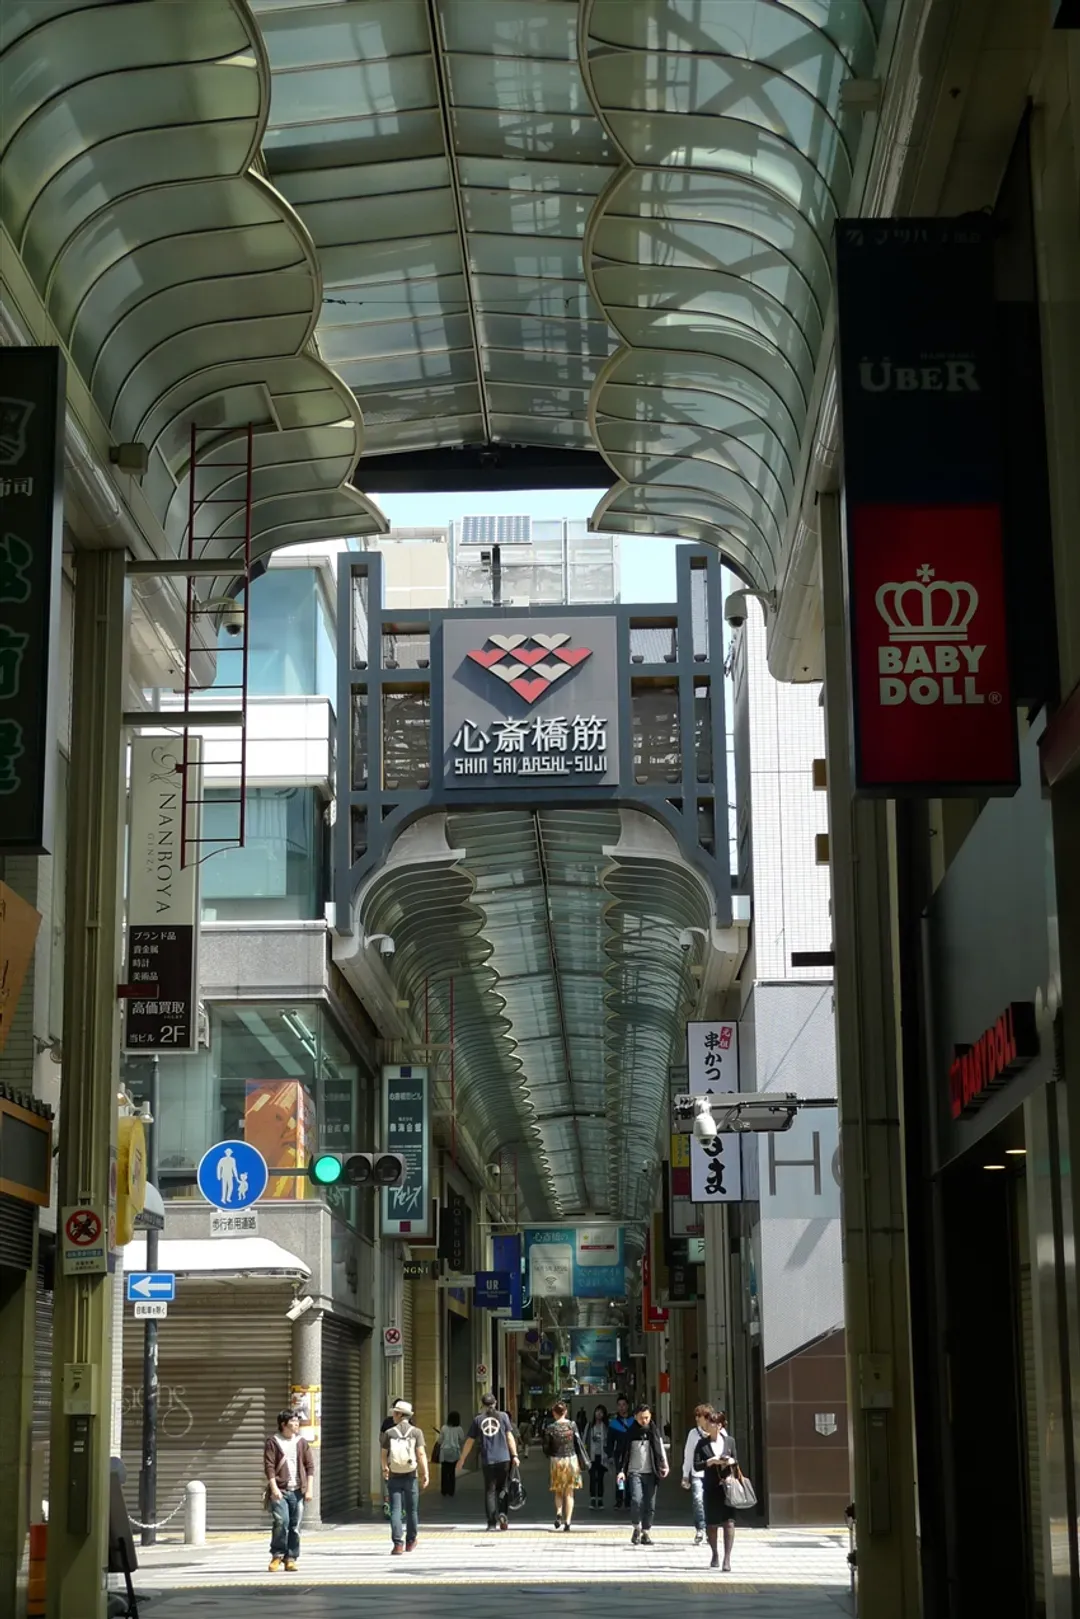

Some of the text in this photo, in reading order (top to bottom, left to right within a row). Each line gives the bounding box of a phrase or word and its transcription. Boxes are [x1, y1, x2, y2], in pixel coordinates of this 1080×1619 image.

[877, 645, 987, 674] BABY
[879, 676, 985, 707] DOLL
[453, 715, 608, 753] 心斎橋筋
[454, 758, 488, 775] SHIN
[156, 793, 177, 913] NANBOYA
[134, 931, 177, 940] ブランド品
[132, 958, 150, 968] 時計
[133, 971, 159, 981] 美術品
[132, 1001, 185, 1015] 高価買取
[128, 1025, 186, 1043] 当ビル 2F
[704, 1032, 722, 1081] 串かつ
[768, 1131, 842, 1195] H
[212, 1217, 256, 1231] 歩行者用道路
[453, 1198, 461, 1236] ROSE
[486, 1279, 499, 1290] UR
[136, 1306, 165, 1316] 自転車を除く
